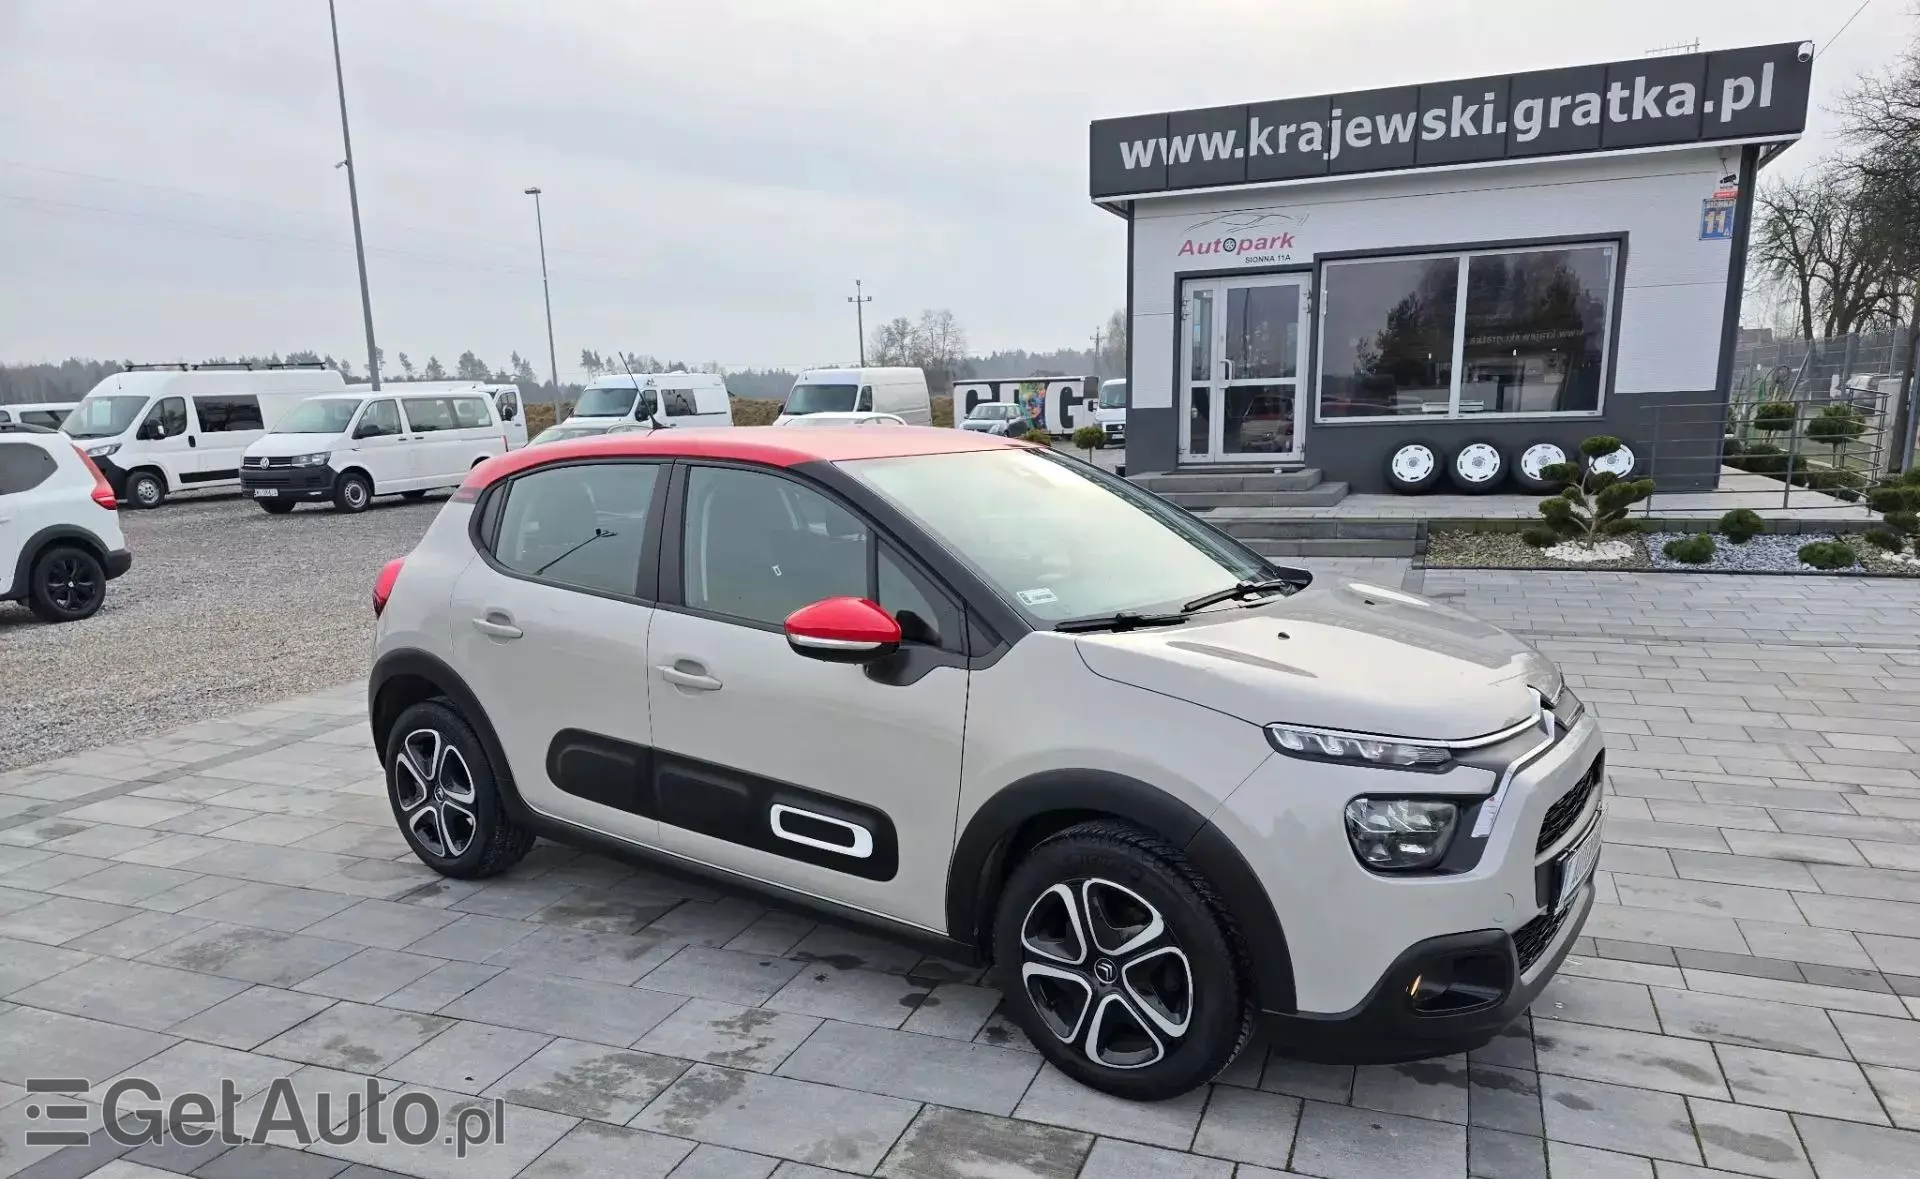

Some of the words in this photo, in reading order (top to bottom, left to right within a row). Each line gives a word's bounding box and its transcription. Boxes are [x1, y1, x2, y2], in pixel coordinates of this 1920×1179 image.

[1120, 62, 1775, 170] www.krajewski.gratka.pl
[1177, 232, 1295, 257] Autopark
[1245, 255, 1275, 264] SIONNA
[1277, 254, 1291, 262] 11A
